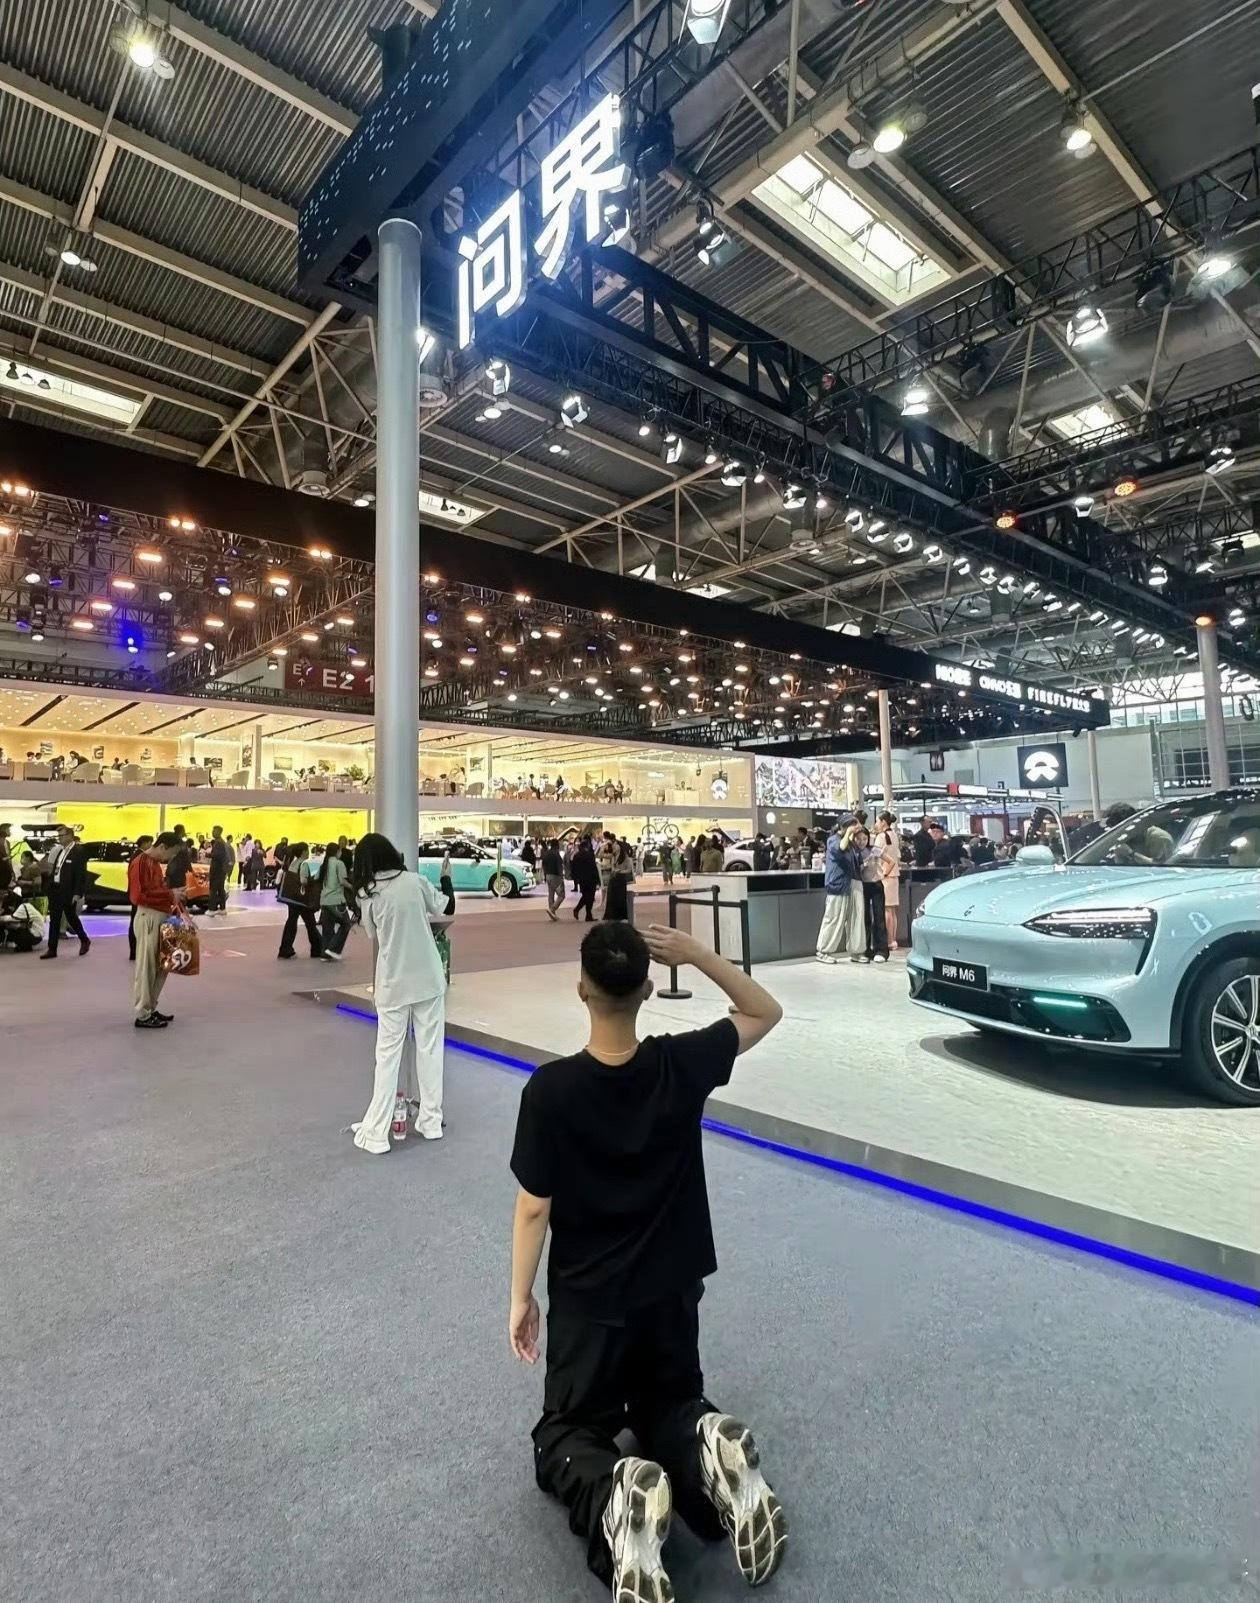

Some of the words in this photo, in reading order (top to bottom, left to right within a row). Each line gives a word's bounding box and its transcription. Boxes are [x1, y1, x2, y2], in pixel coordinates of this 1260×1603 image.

[458, 92, 628, 350] 问界
[322, 668, 354, 690] E2
[959, 967, 975, 982] M6
